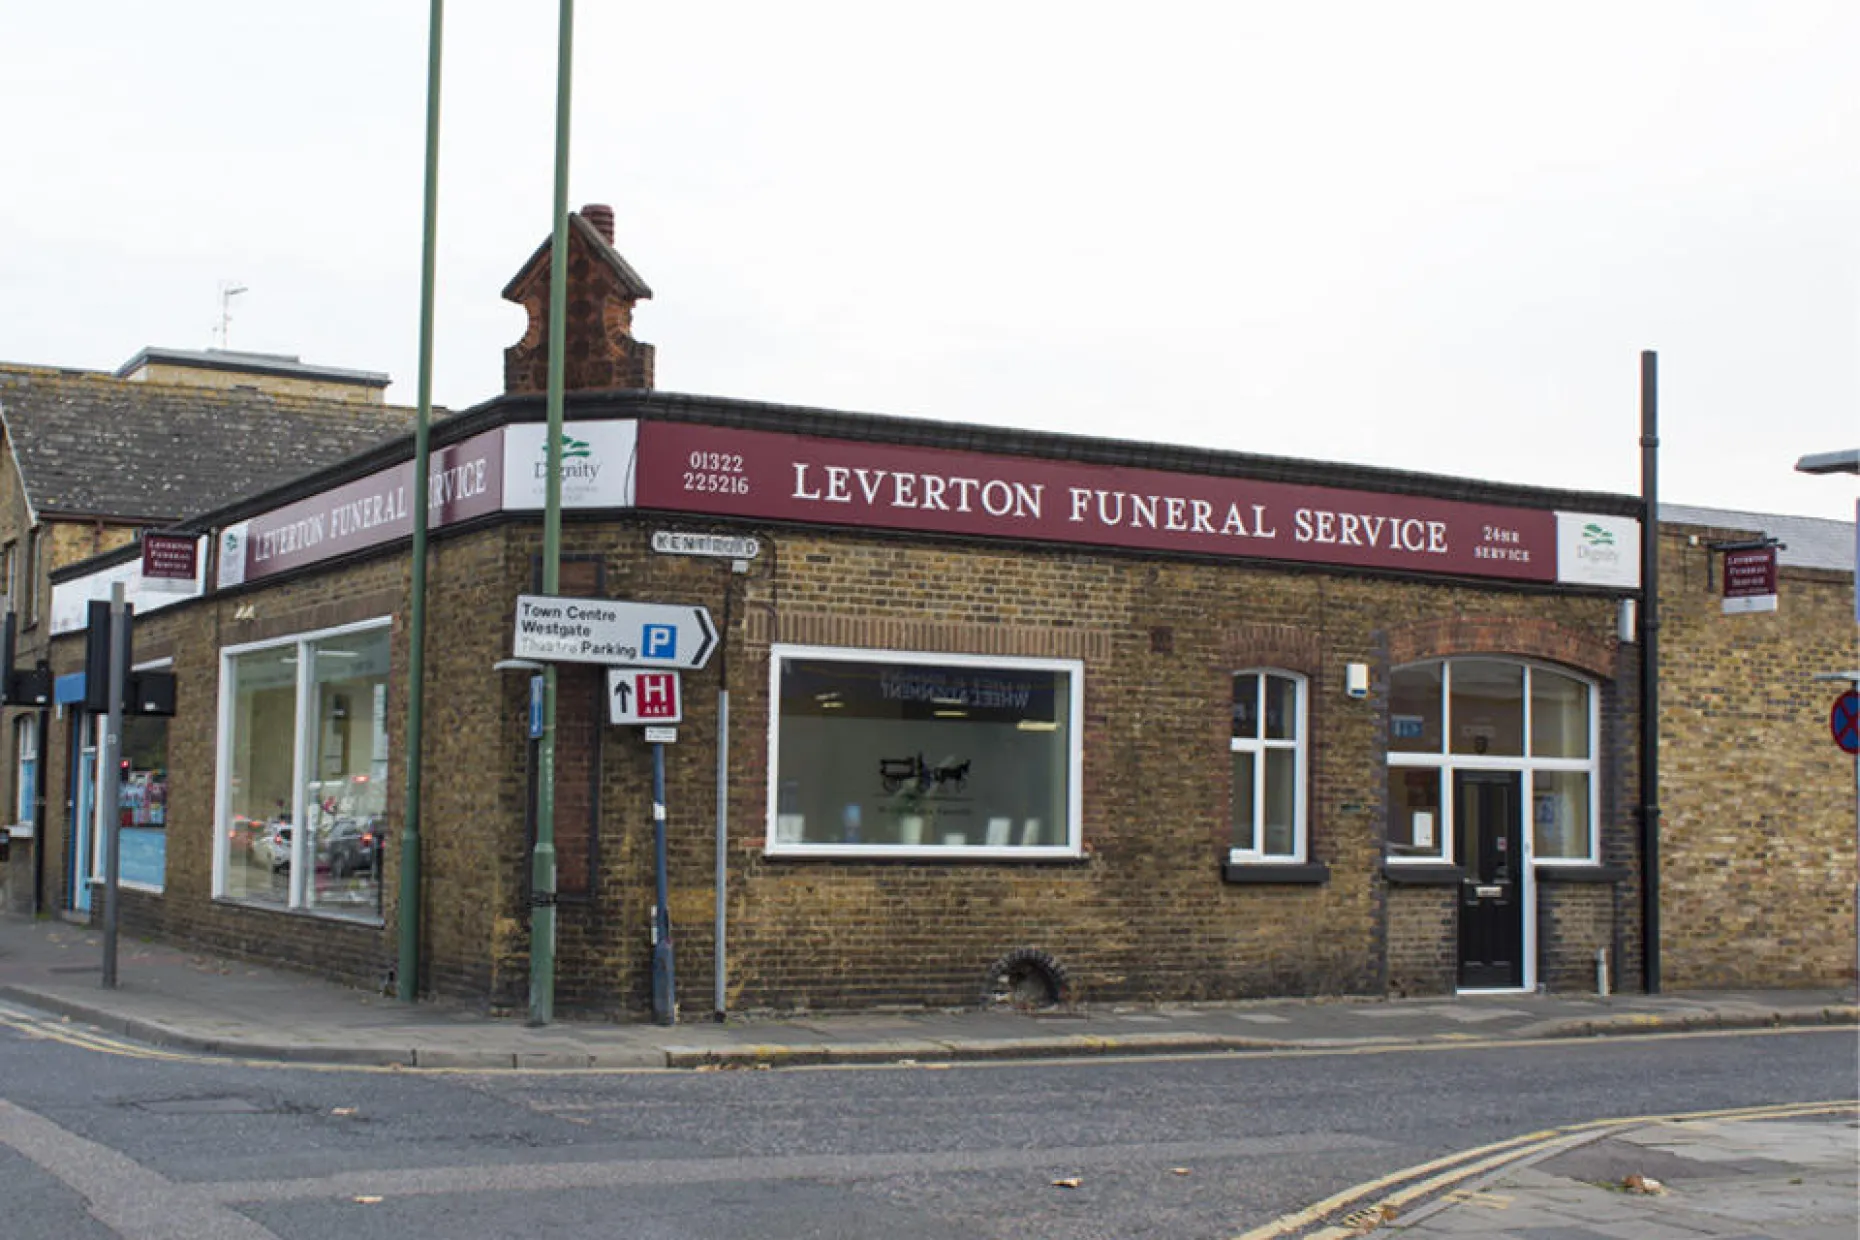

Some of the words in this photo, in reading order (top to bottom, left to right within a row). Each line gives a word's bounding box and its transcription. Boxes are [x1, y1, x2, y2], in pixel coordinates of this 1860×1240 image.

[534, 460, 602, 484] Dgnity
[689, 450, 744, 473] 01322
[683, 471, 749, 495] 225216
[254, 512, 325, 563] LEVERTON
[329, 486, 408, 539] FUNERAL
[428, 458, 487, 509] RVICE
[791, 462, 1045, 519] LEVERTON
[1068, 487, 1276, 539] FUNERAL
[1294, 508, 1449, 554] SERVICE
[1474, 545, 1531, 563] SERVICE
[522, 602, 562, 618] Town
[566, 605, 617, 622] Centre
[521, 620, 592, 639] Westgate
[649, 627, 670, 656] P
[580, 640, 637, 660] Parking
[644, 675, 667, 704] H
